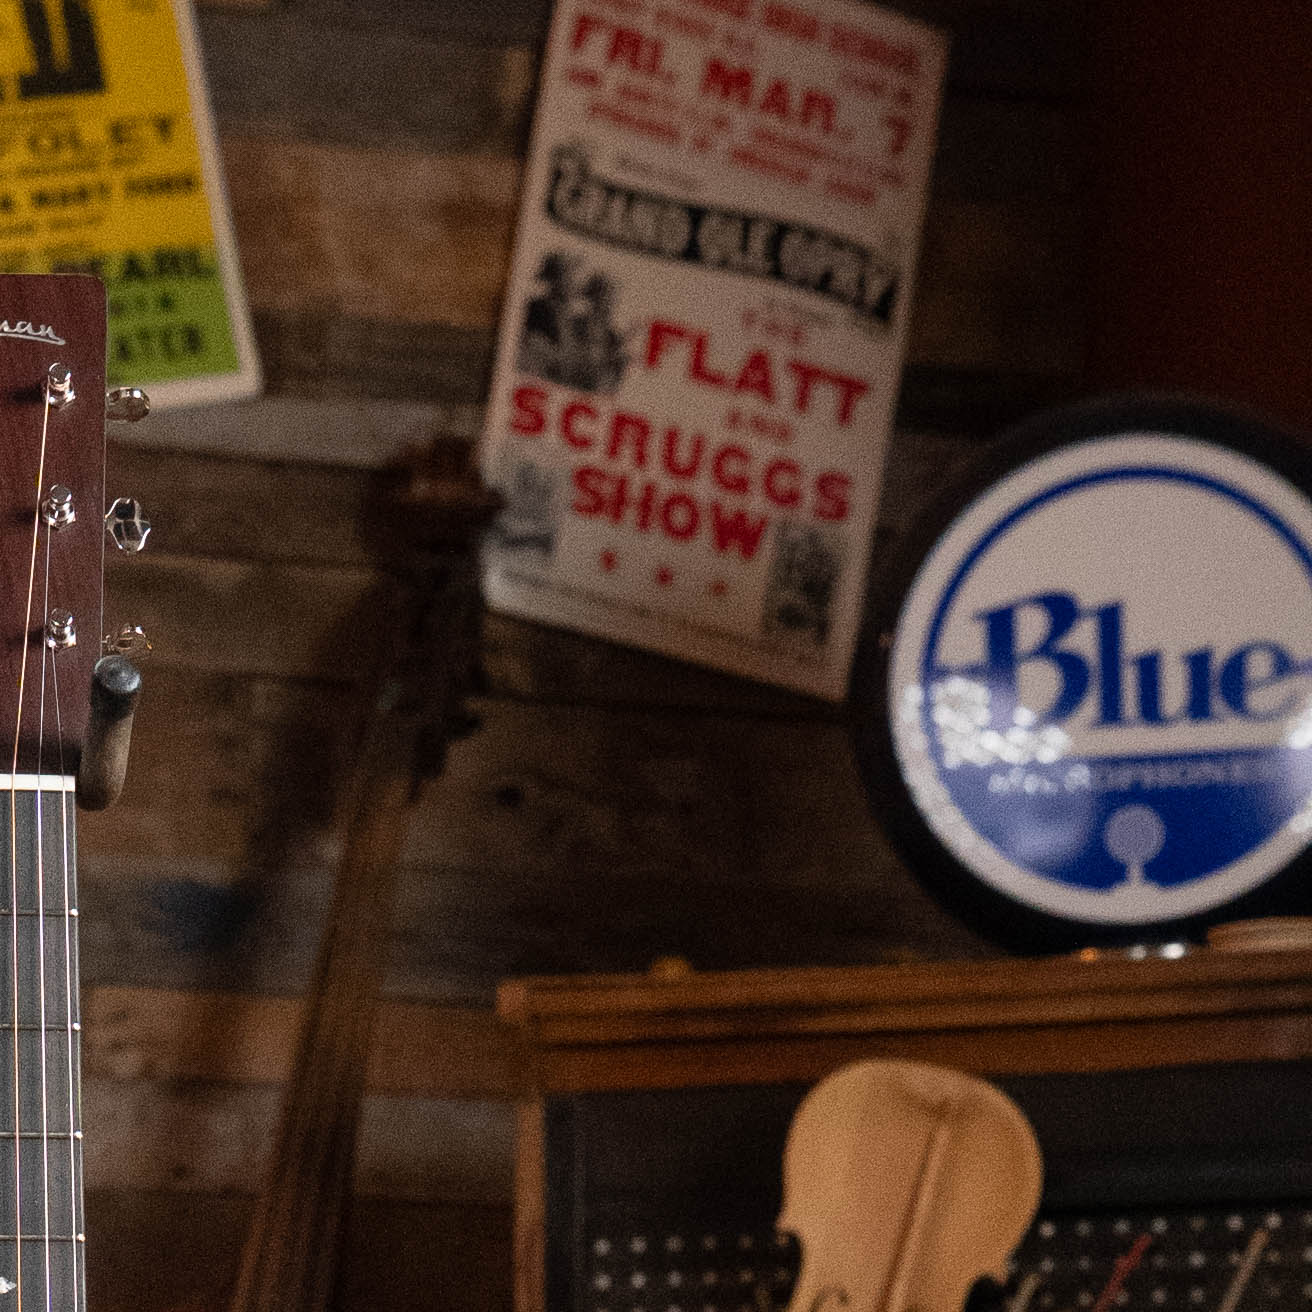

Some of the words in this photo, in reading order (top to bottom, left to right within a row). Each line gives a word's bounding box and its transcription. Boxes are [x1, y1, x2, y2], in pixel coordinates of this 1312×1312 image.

[643, 318, 870, 429] FLATT
[509, 385, 852, 523] SCRUGGS
[571, 464, 769, 560] SHOW
[972, 590, 1300, 729] Blue
